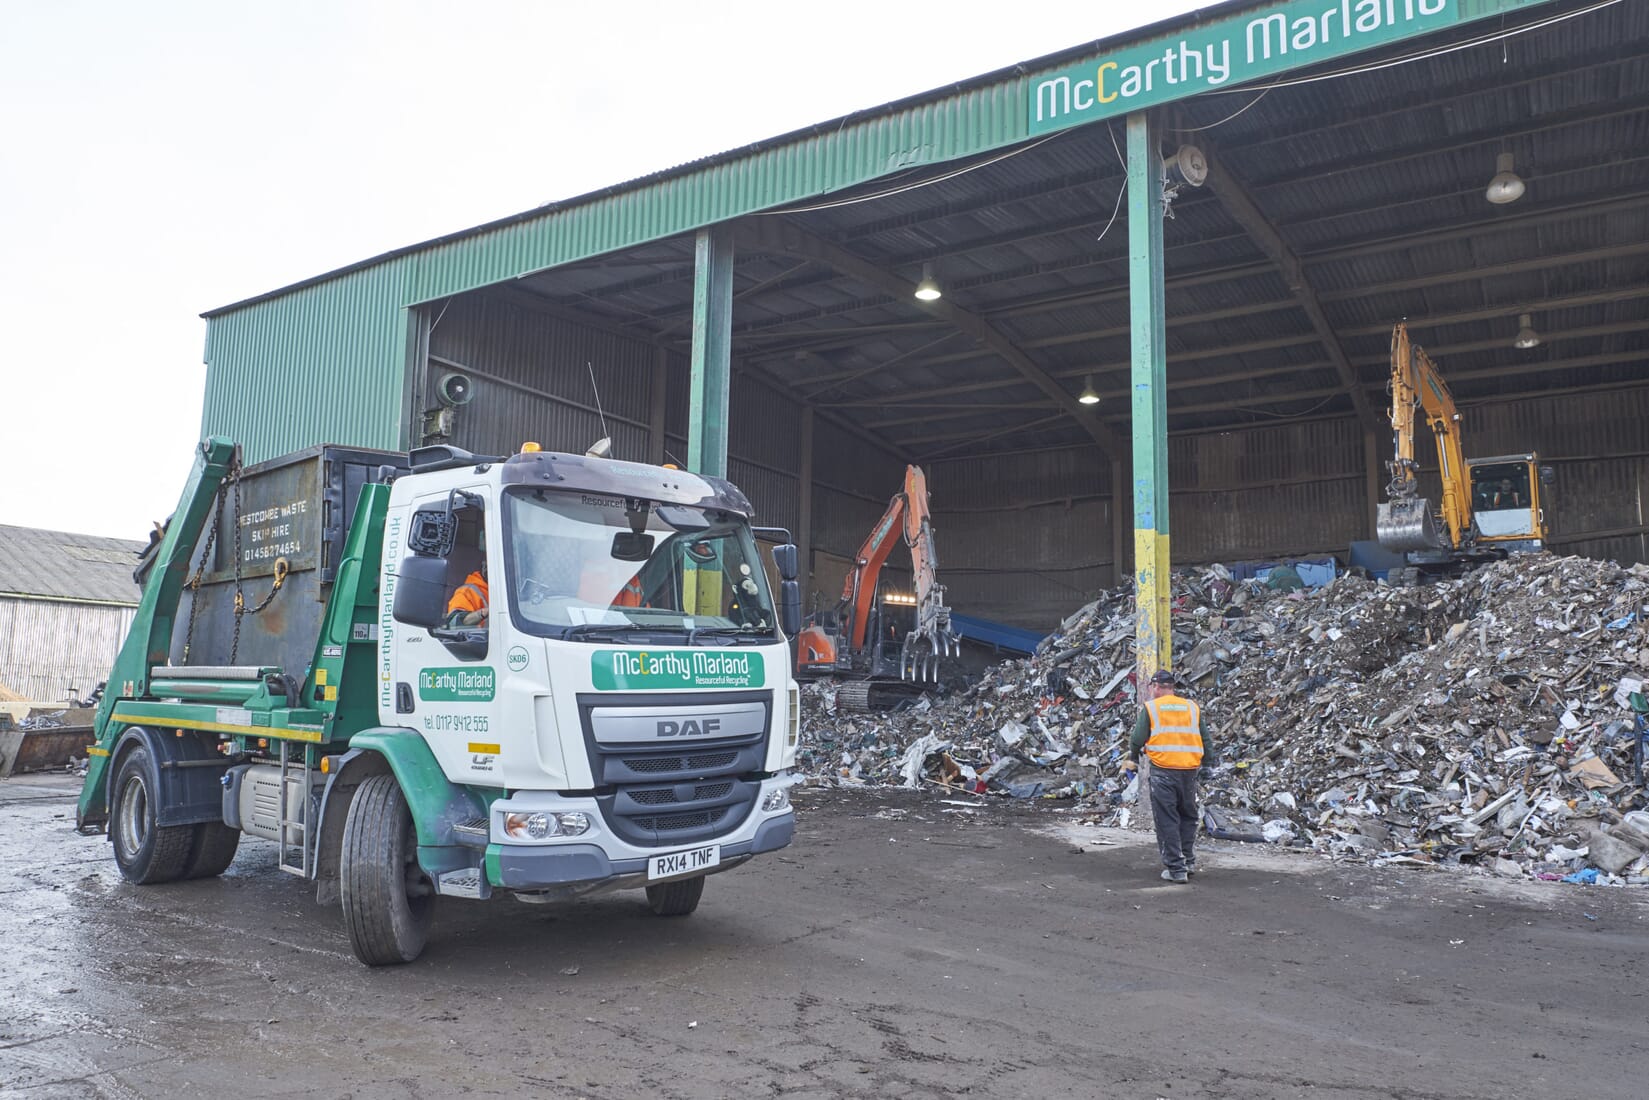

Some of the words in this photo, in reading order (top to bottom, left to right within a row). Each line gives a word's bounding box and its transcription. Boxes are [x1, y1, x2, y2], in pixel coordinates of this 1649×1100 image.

[1037, 40, 1230, 121] McCarthy
[281, 500, 307, 517] WASTE
[271, 523, 290, 538] HIRE
[509, 654, 527, 663] SK06
[613, 652, 690, 680] McCarthy
[693, 652, 749, 675] Marland
[420, 672, 456, 692] McCarthy
[458, 671, 493, 688] Marland
[436, 715, 452, 731] 0117
[454, 715, 472, 732] 9412
[473, 716, 489, 732] 555
[656, 718, 721, 737] DAF
[657, 853, 688, 875] RX14
[690, 847, 714, 868] TNF
